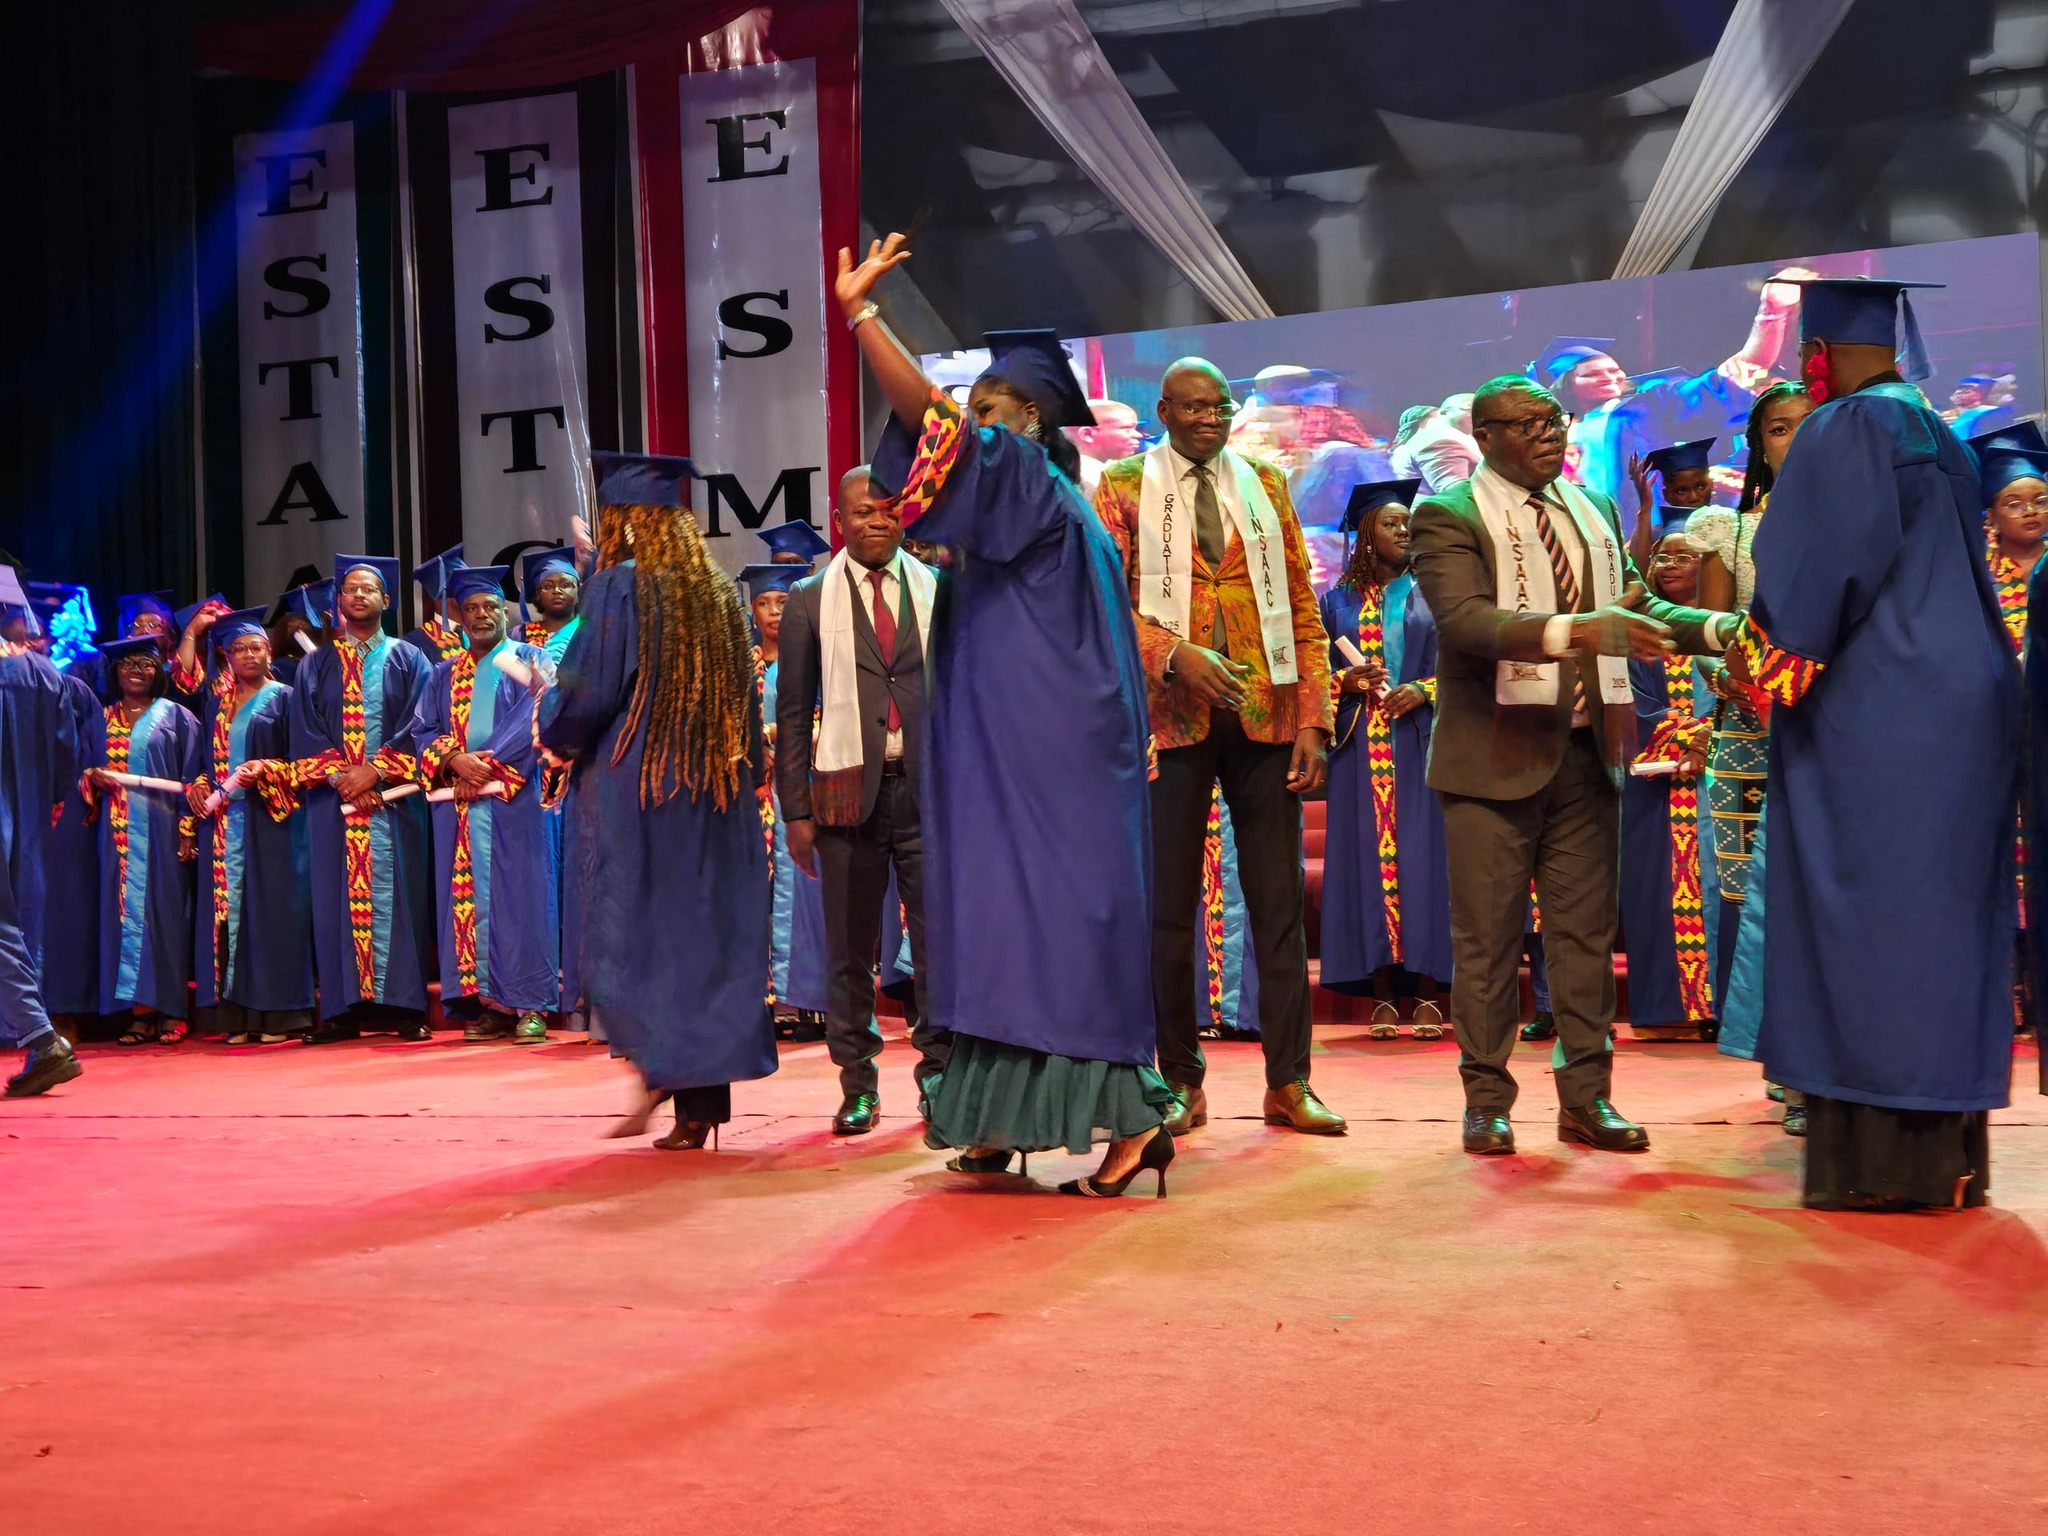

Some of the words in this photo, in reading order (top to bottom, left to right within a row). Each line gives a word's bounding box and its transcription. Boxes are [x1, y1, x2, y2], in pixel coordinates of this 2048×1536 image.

[703, 110, 822, 538] ESM
[1162, 493, 1175, 599] GRADUATION
[1248, 501, 1274, 608] INSAAC
[1604, 538, 1617, 601] GRADU
[1162, 620, 1180, 630] 025
